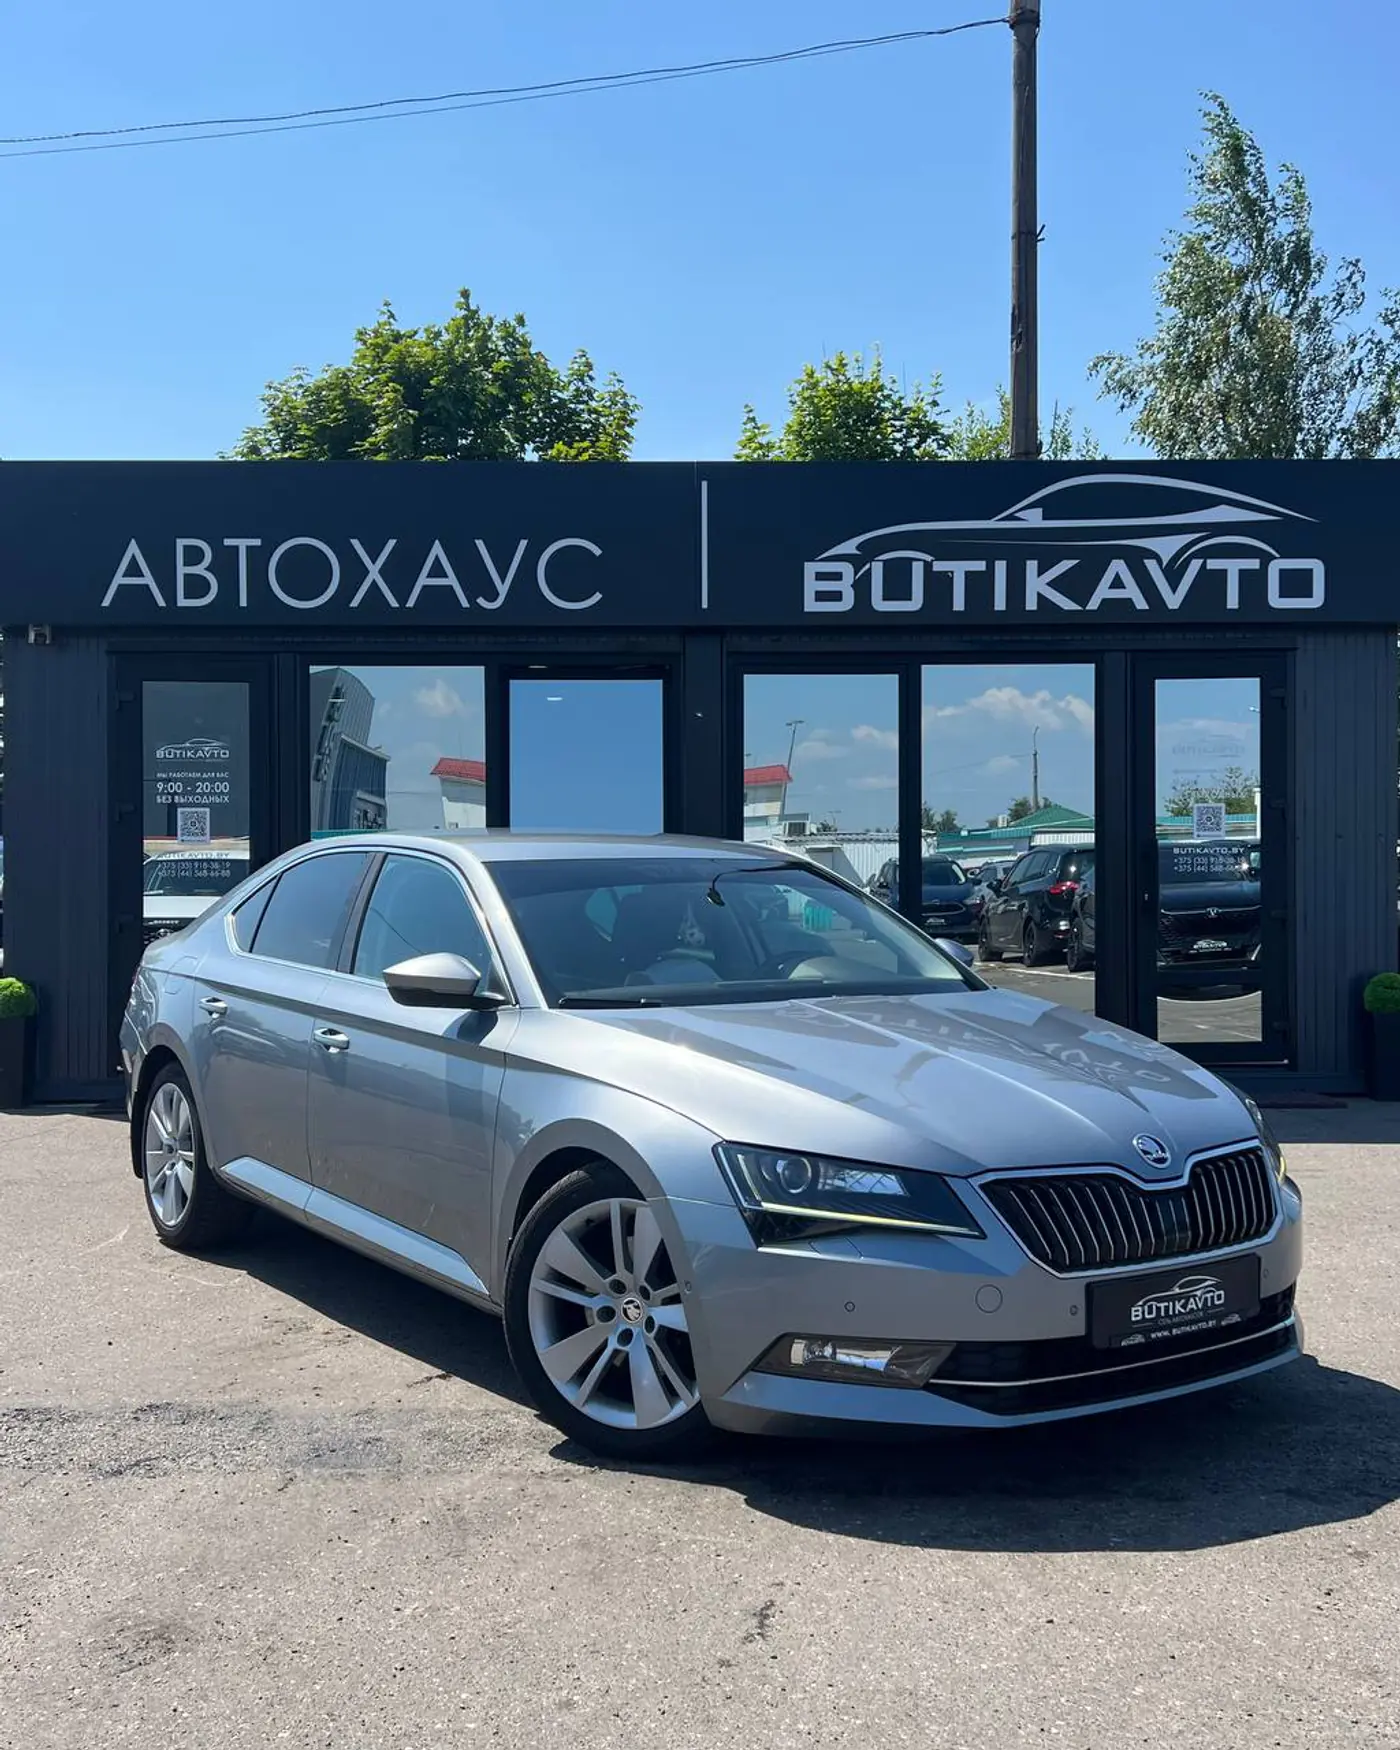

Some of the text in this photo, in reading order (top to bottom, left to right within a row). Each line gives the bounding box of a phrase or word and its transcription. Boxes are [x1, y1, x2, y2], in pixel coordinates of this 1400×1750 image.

[101, 536, 603, 610] АВТОХАУС
[804, 558, 1325, 613] BUTIKAVTO
[156, 749, 230, 759] BUTIKAVTO
[156, 782, 183, 793] 9:00
[195, 782, 230, 793] 20:00
[156, 795, 230, 804] БЕЗ ВЫХОДНЫХ
[1173, 847, 1245, 855] BUTIKAVTO.BY
[1131, 1290, 1225, 1321] BUTIKAVTO
